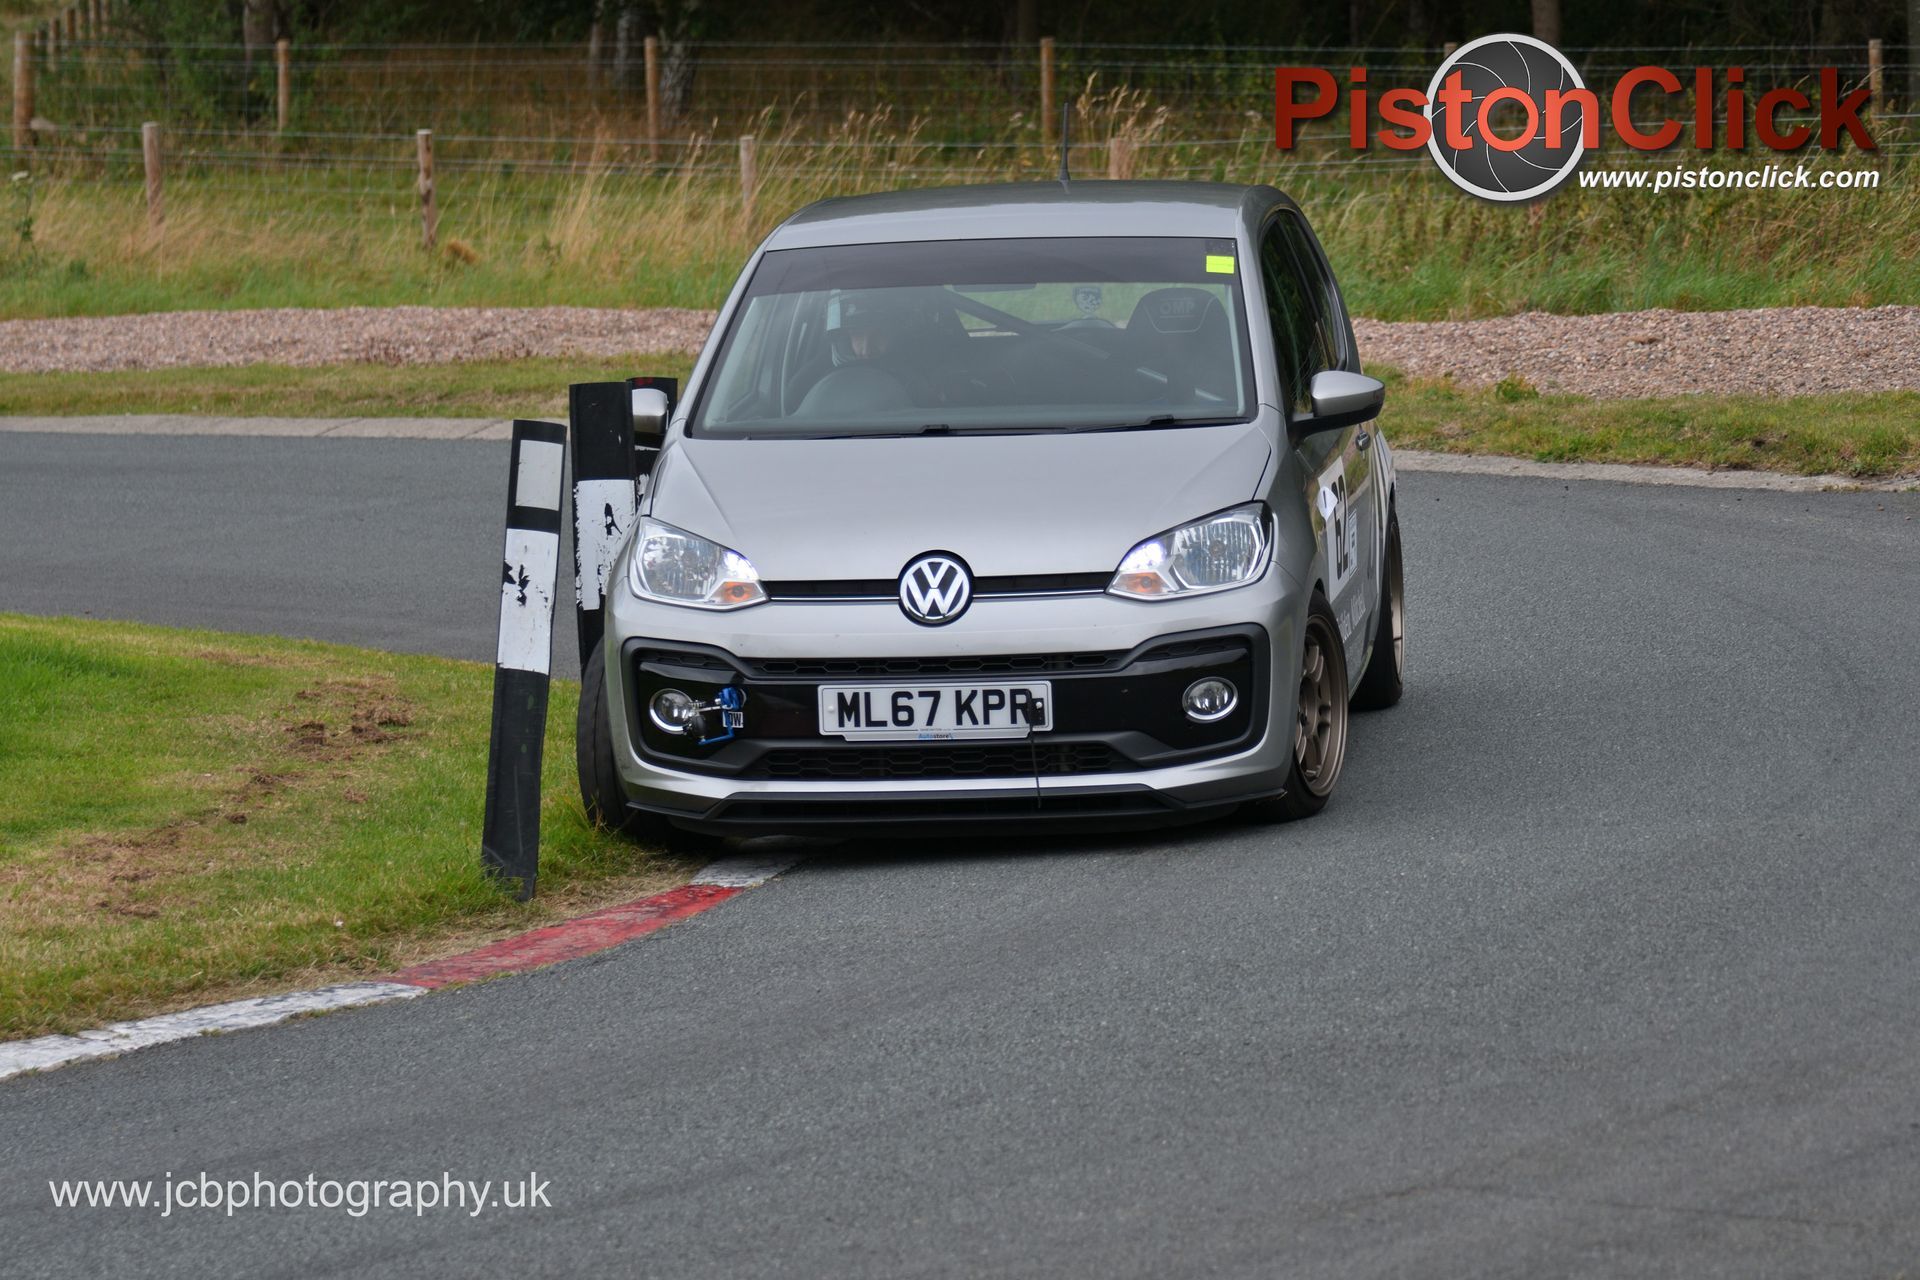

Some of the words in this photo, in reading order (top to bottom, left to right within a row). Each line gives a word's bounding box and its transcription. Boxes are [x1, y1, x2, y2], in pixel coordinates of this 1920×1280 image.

[900, 557, 969, 623] VW
[837, 690, 941, 728] ML67
[955, 688, 1033, 726] KPR
